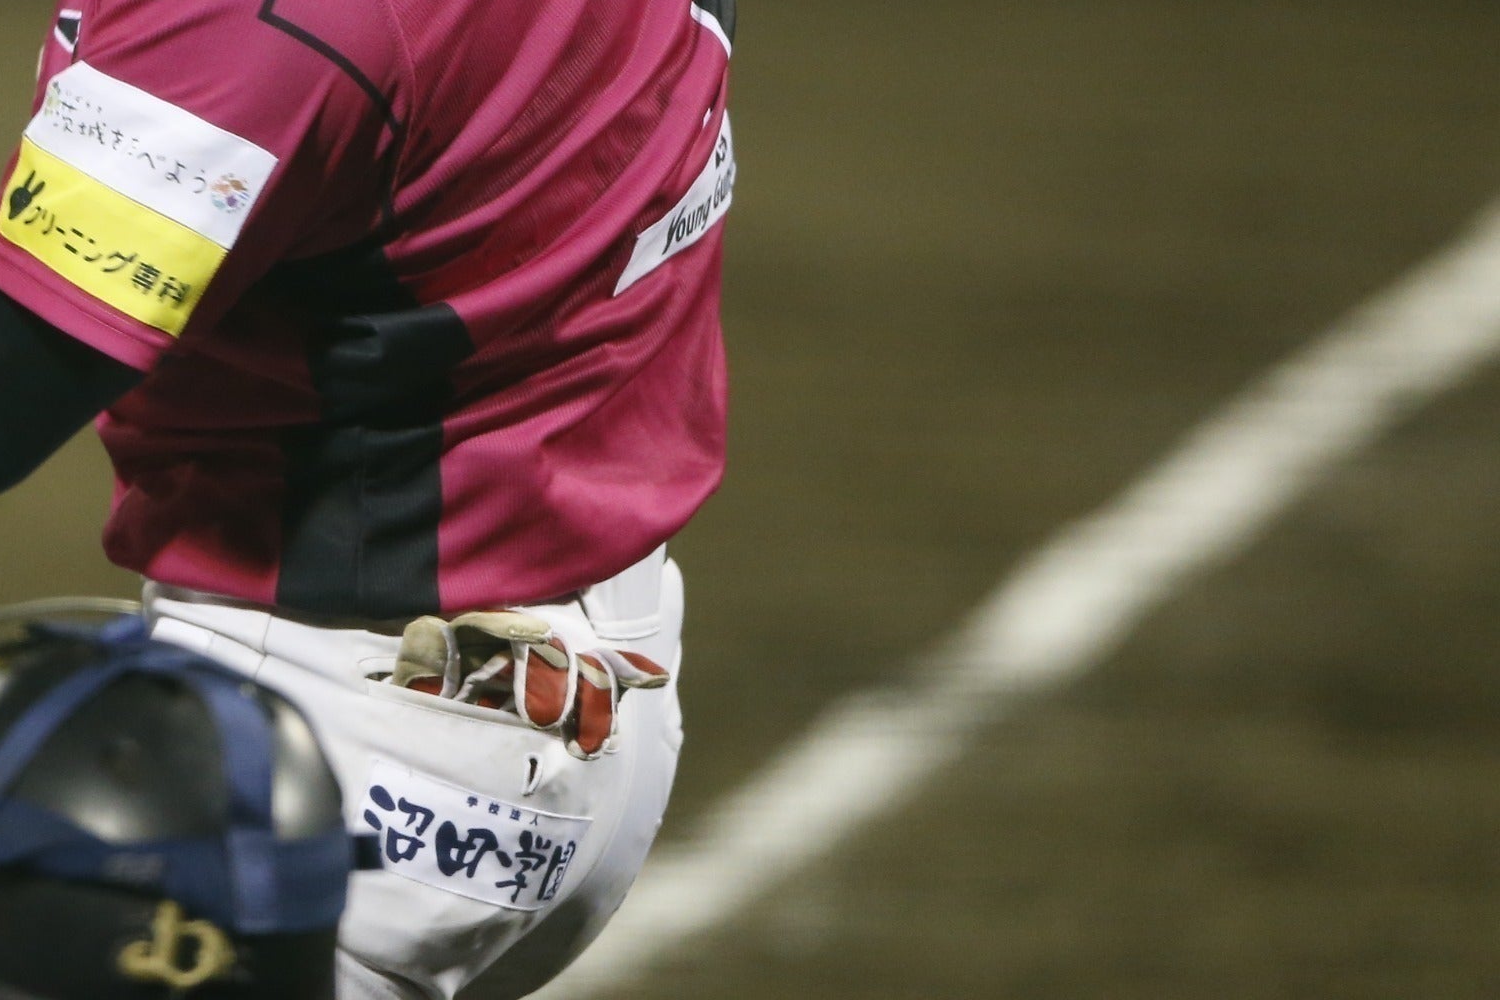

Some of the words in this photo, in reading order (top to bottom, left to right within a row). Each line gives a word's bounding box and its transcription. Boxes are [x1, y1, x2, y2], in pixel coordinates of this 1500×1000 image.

[662, 195, 712, 255] Young
[466, 795, 540, 826] 学校法人
